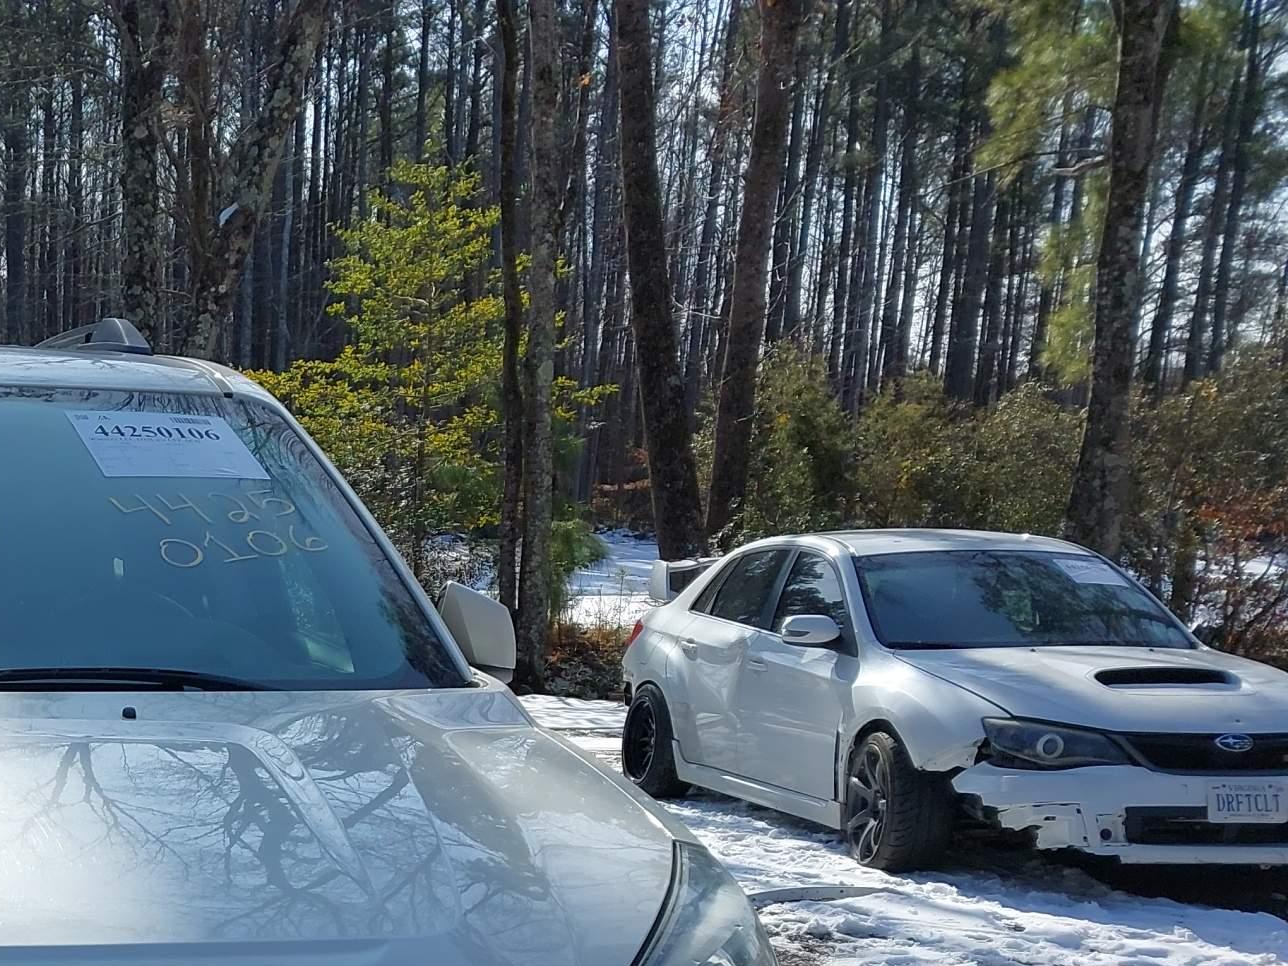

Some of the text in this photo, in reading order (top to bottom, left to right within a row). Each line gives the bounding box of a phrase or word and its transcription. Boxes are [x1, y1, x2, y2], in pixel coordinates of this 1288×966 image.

[94, 424, 221, 441] 44250106
[109, 489, 296, 526] 4425
[159, 524, 329, 568] 0106
[1215, 793, 1281, 813] DRFTCLT
